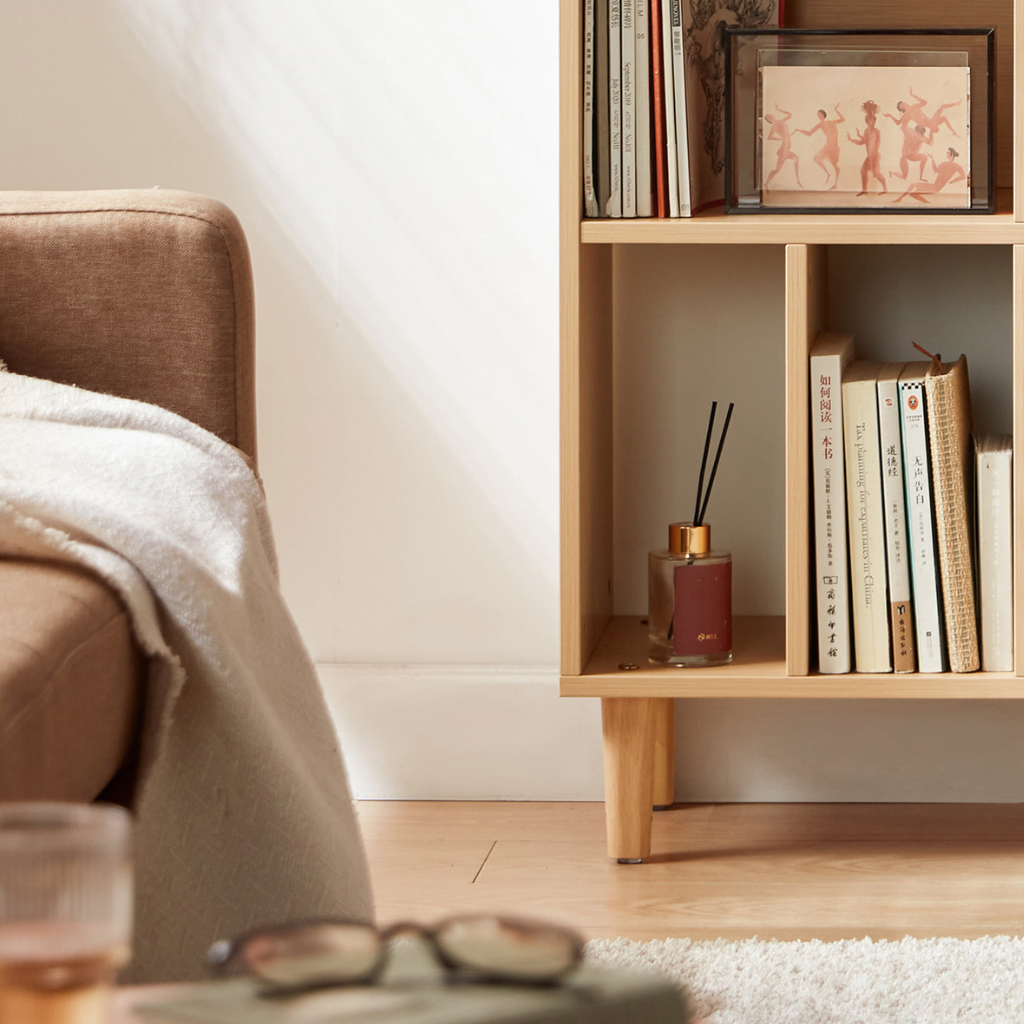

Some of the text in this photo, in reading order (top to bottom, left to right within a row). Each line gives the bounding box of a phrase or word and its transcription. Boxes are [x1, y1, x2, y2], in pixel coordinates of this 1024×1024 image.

[819, 374, 834, 460] 如何阅读一本书
[856, 422, 866, 440] Tax
[855, 443, 867, 488] planning
[886, 444, 899, 478] 道德经
[912, 455, 925, 505] 无声告白
[860, 490, 870, 504] for
[858, 506, 872, 560] expatriates
[863, 563, 874, 573] in
